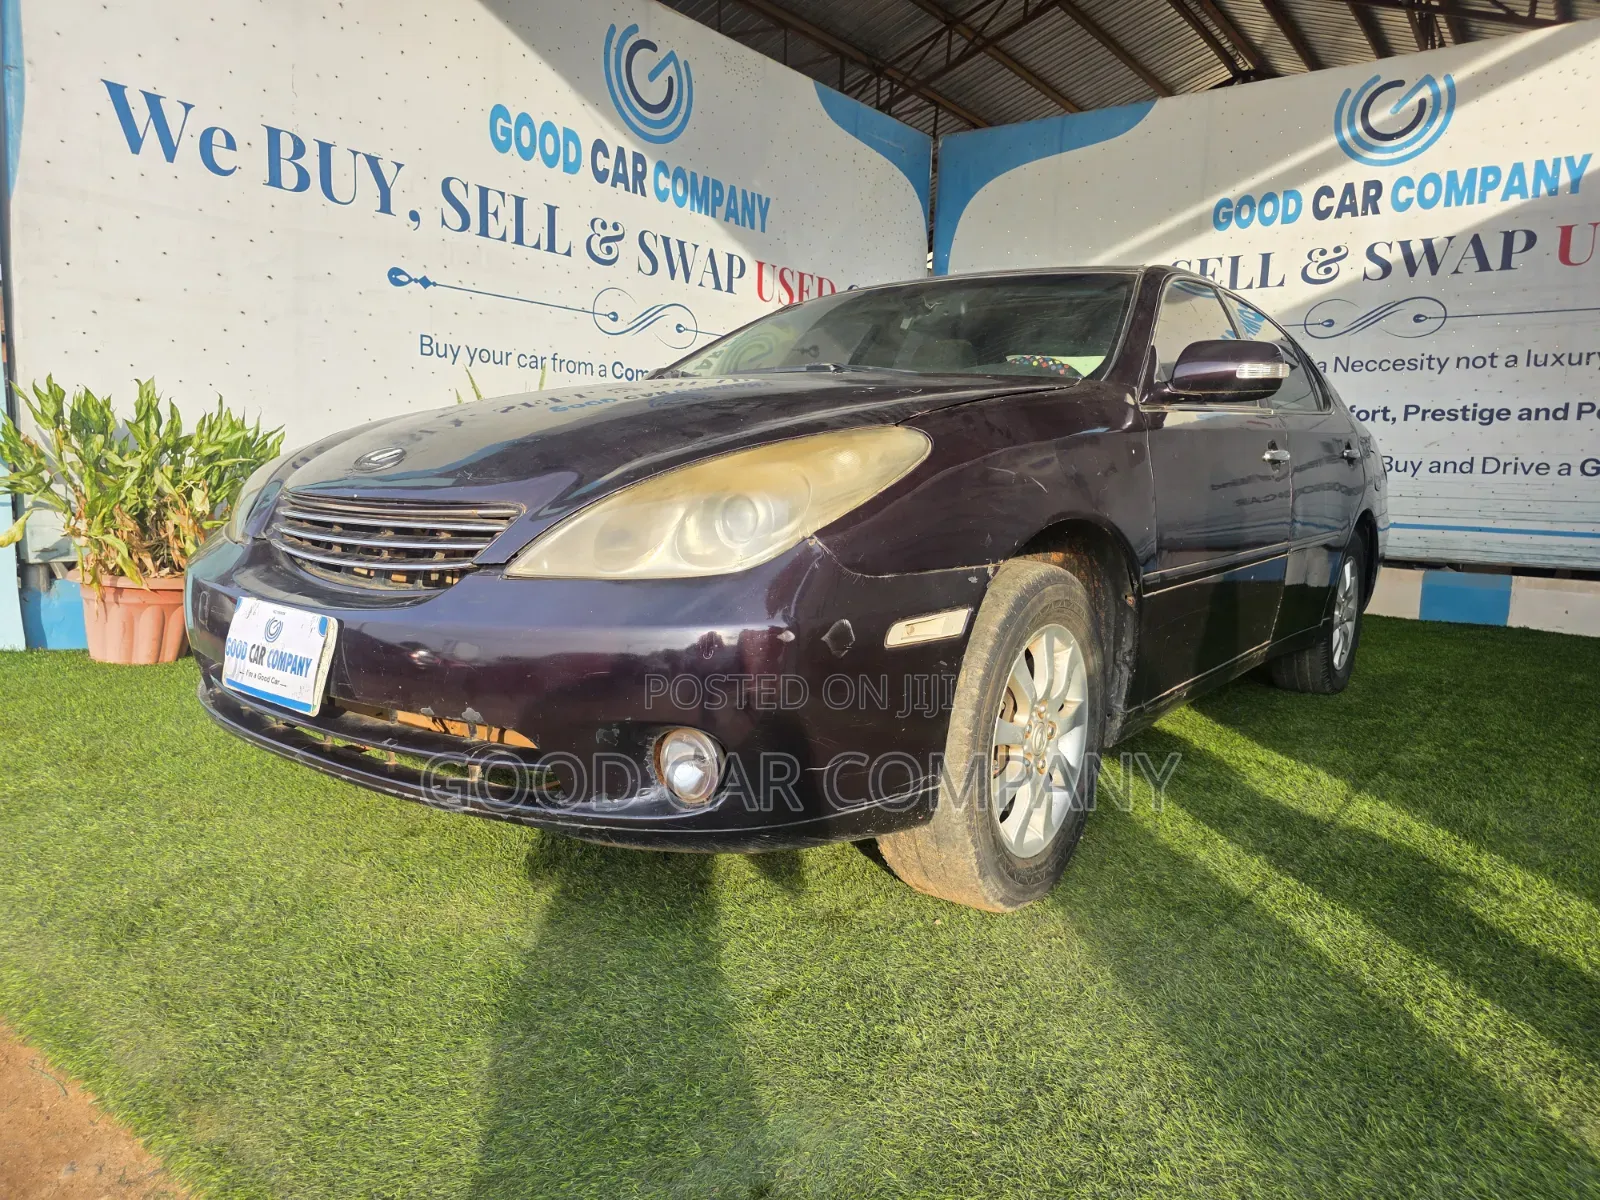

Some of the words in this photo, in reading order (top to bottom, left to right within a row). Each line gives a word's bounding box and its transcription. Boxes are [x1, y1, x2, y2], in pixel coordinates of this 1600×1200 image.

[100, 78, 238, 178] We
[261, 124, 421, 231] BUY,
[440, 176, 573, 258] SELL
[585, 217, 625, 267] &
[637, 229, 746, 296] SWAP
[489, 103, 582, 176] GOOD
[590, 138, 647, 198] CAR
[653, 159, 771, 233] COMPANY
[1212, 189, 1302, 232] GOOD
[1312, 179, 1383, 221] CAR
[1391, 153, 1593, 213] COMPANY
[1171, 251, 1286, 291] ELL
[1301, 245, 1349, 285] &
[1363, 229, 1537, 282] SWAP
[419, 334, 461, 365] Buy
[465, 345, 512, 367] your
[517, 353, 547, 370] car
[551, 353, 594, 376] from
[598, 364, 607, 378] a
[1333, 353, 1450, 374] Neccesity
[1456, 352, 1498, 369] not
[1504, 354, 1518, 368] a
[1403, 404, 1511, 426] Prestige
[1517, 402, 1570, 421] and
[1382, 455, 1423, 478] Buy
[1428, 456, 1474, 474] and
[1481, 456, 1551, 476] Drive
[1557, 462, 1571, 476] a
[225, 637, 248, 660] GOOD
[249, 644, 266, 666] CAR
[266, 649, 313, 678] COMPANY
[257, 673, 270, 683] Good
[270, 677, 280, 685] Car
